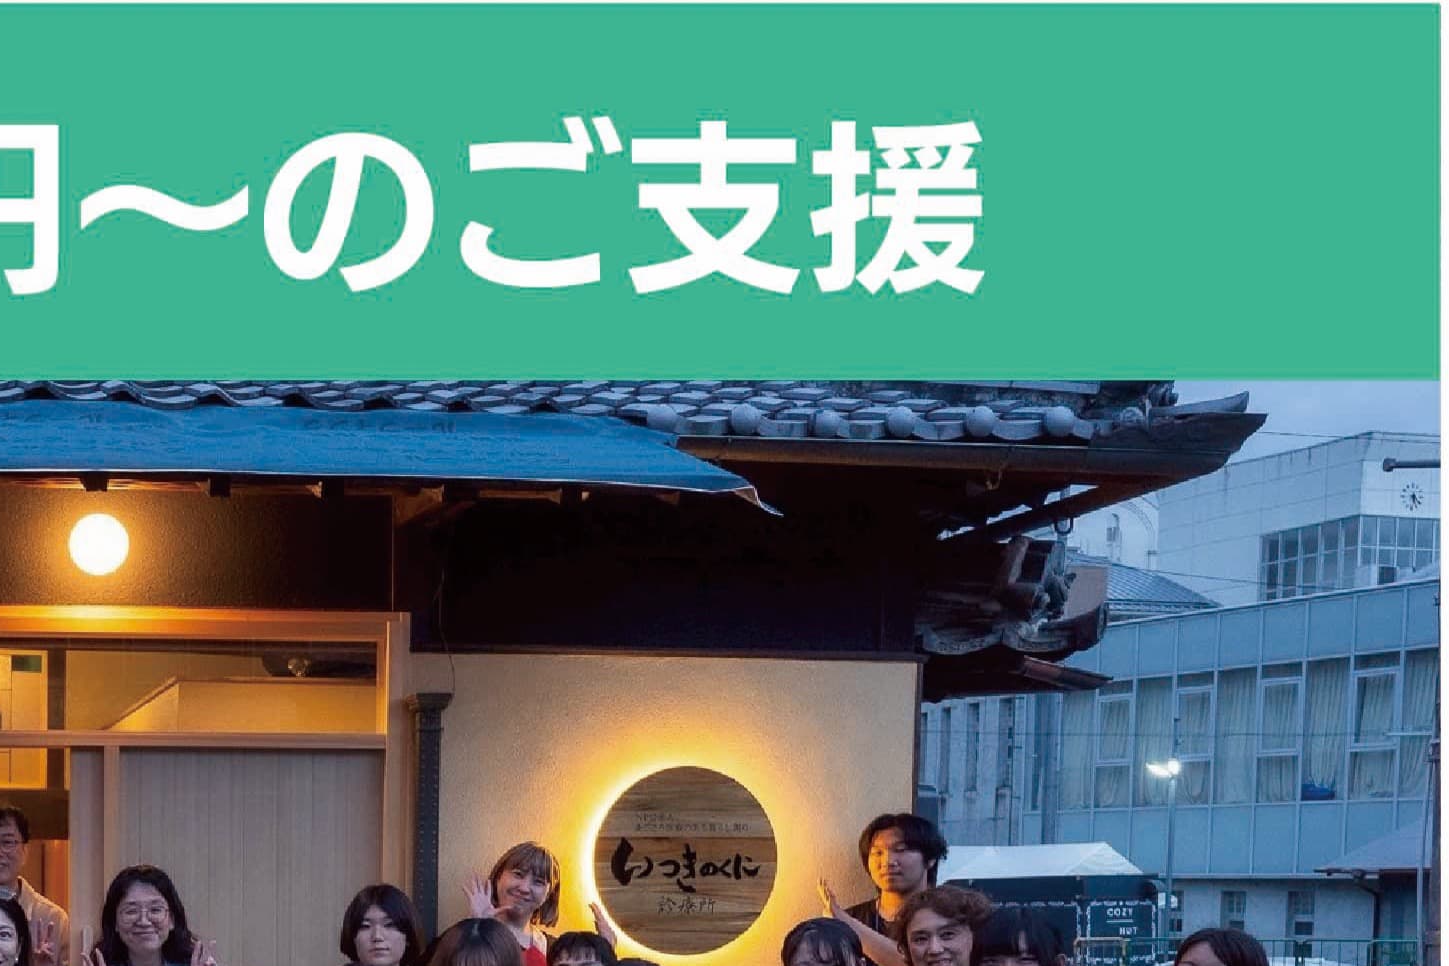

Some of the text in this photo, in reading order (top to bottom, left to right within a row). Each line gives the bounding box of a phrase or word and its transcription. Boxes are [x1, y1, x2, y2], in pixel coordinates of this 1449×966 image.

[611, 837, 761, 893] いつきのくに
[657, 896, 717, 915] 診療所
